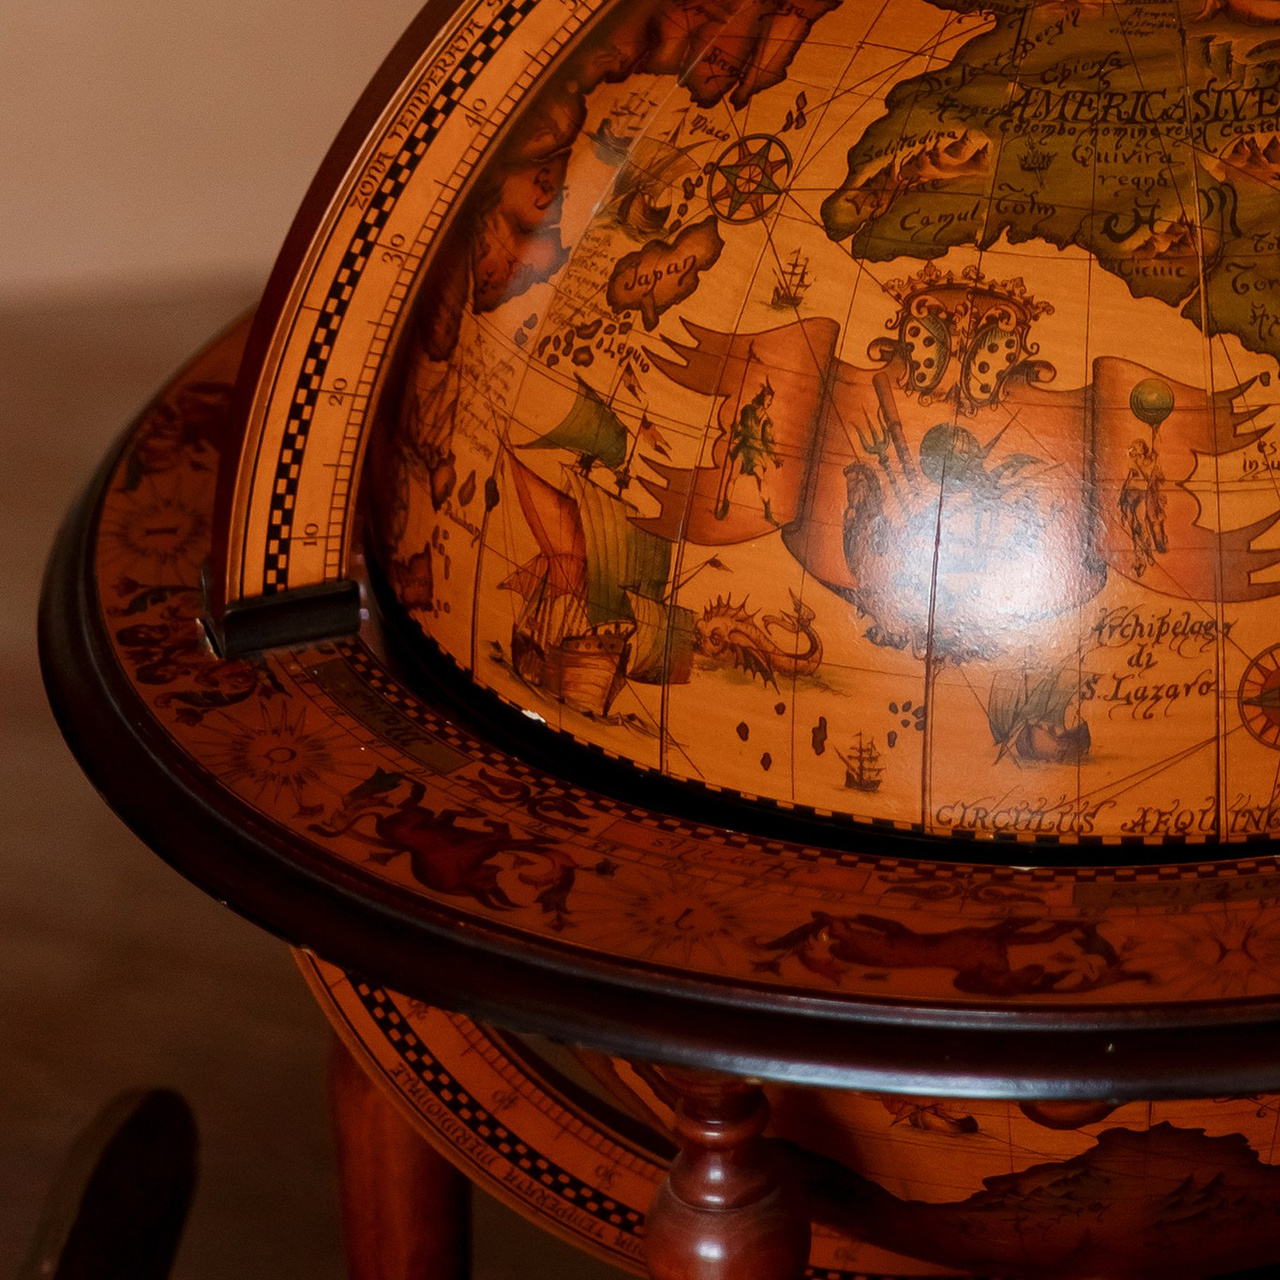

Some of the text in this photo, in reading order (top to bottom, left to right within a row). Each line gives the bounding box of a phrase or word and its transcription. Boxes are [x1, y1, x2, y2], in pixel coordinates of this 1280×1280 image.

[464, 97, 488, 128] 40
[381, 232, 405, 265] 30
[623, 254, 697, 297] Japan
[329, 377, 348, 407] 20
[303, 523, 318, 547] 10
